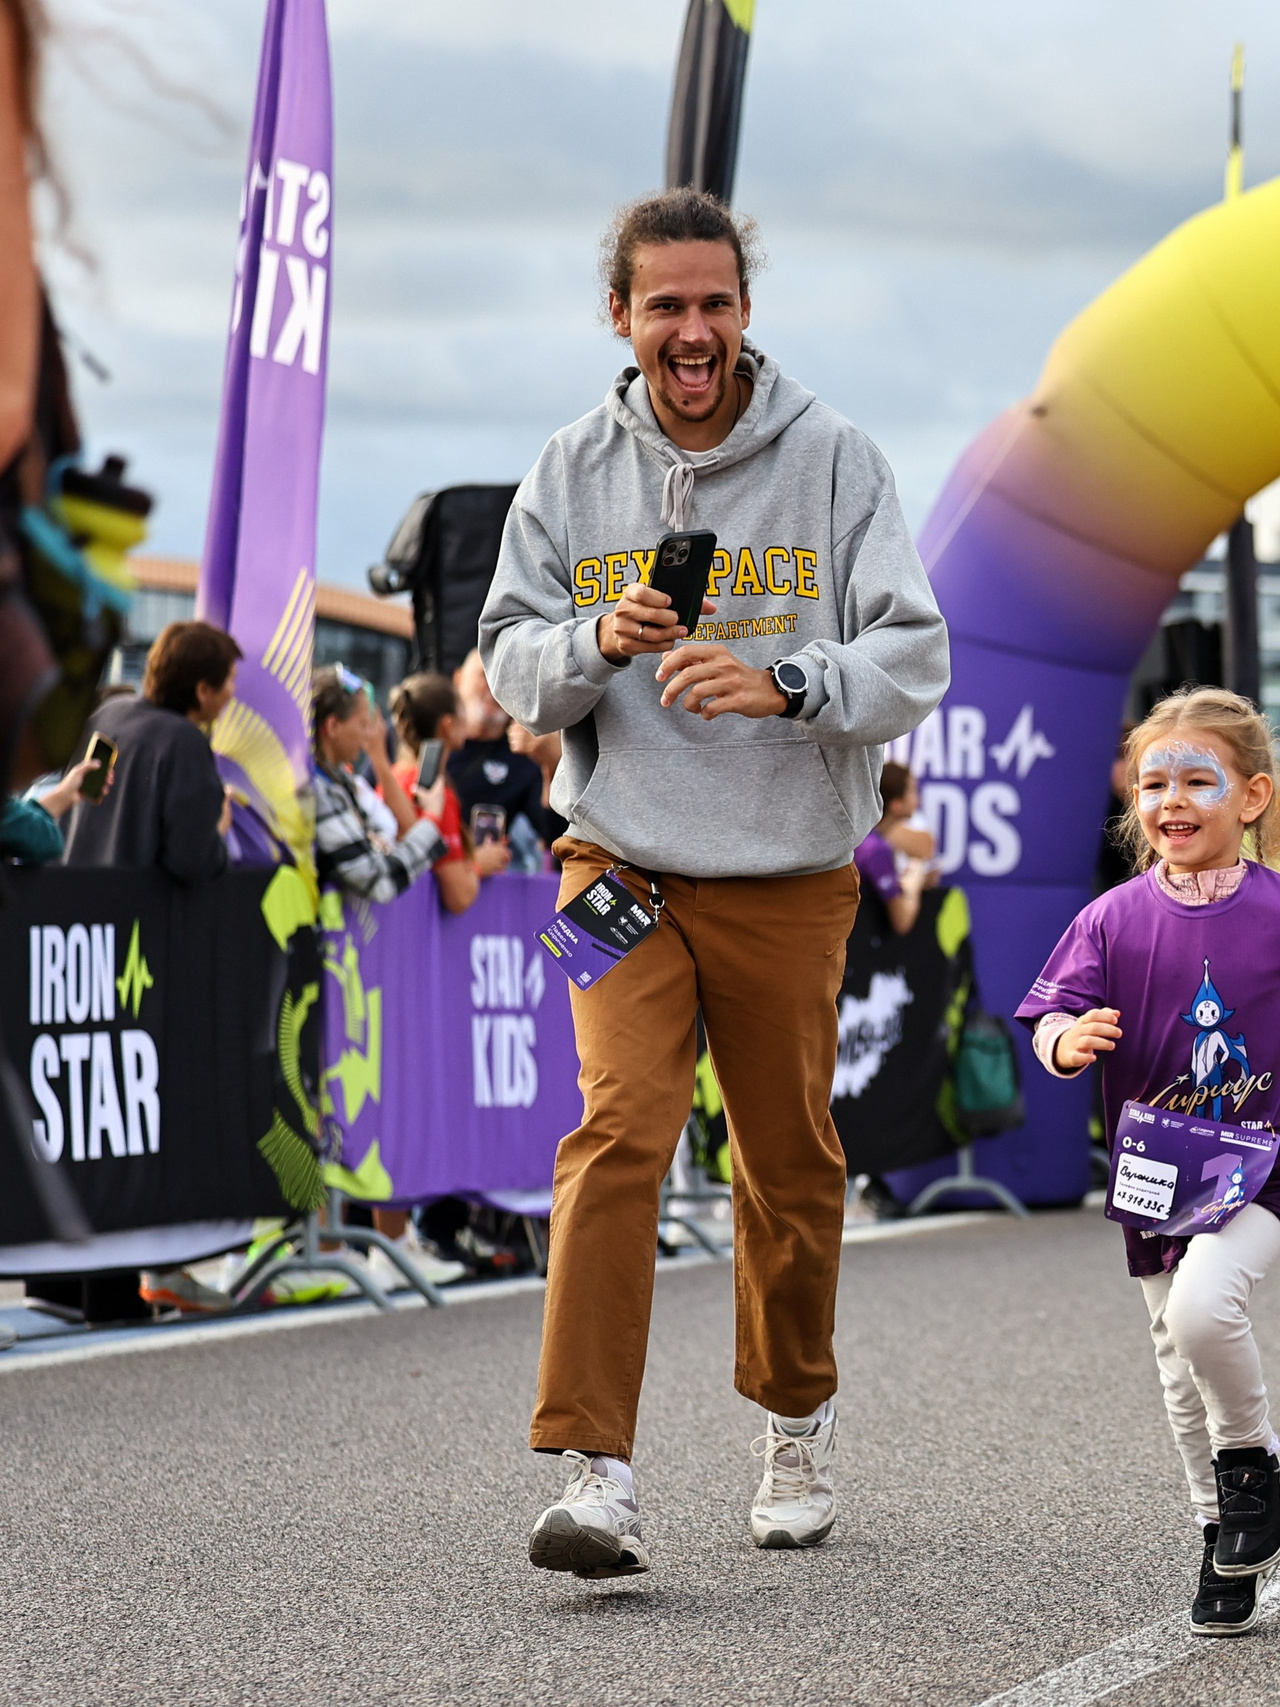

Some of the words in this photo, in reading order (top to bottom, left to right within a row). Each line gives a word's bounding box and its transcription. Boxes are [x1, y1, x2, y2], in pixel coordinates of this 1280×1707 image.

[705, 546, 819, 600] PACE
[884, 705, 987, 780] AR
[586, 889, 611, 916] STAR
[594, 881, 614, 902] IRON
[630, 904, 651, 927] MIR
[556, 918, 578, 945] МЕДИА
[29, 922, 115, 1025] IRON
[471, 1013, 538, 1109] KIDS
[30, 1029, 161, 1164] STAR
[1240, 1120, 1263, 1130] STAR
[1122, 1136, 1146, 1152] 0-6
[1235, 1133, 1273, 1147] SUPREME
